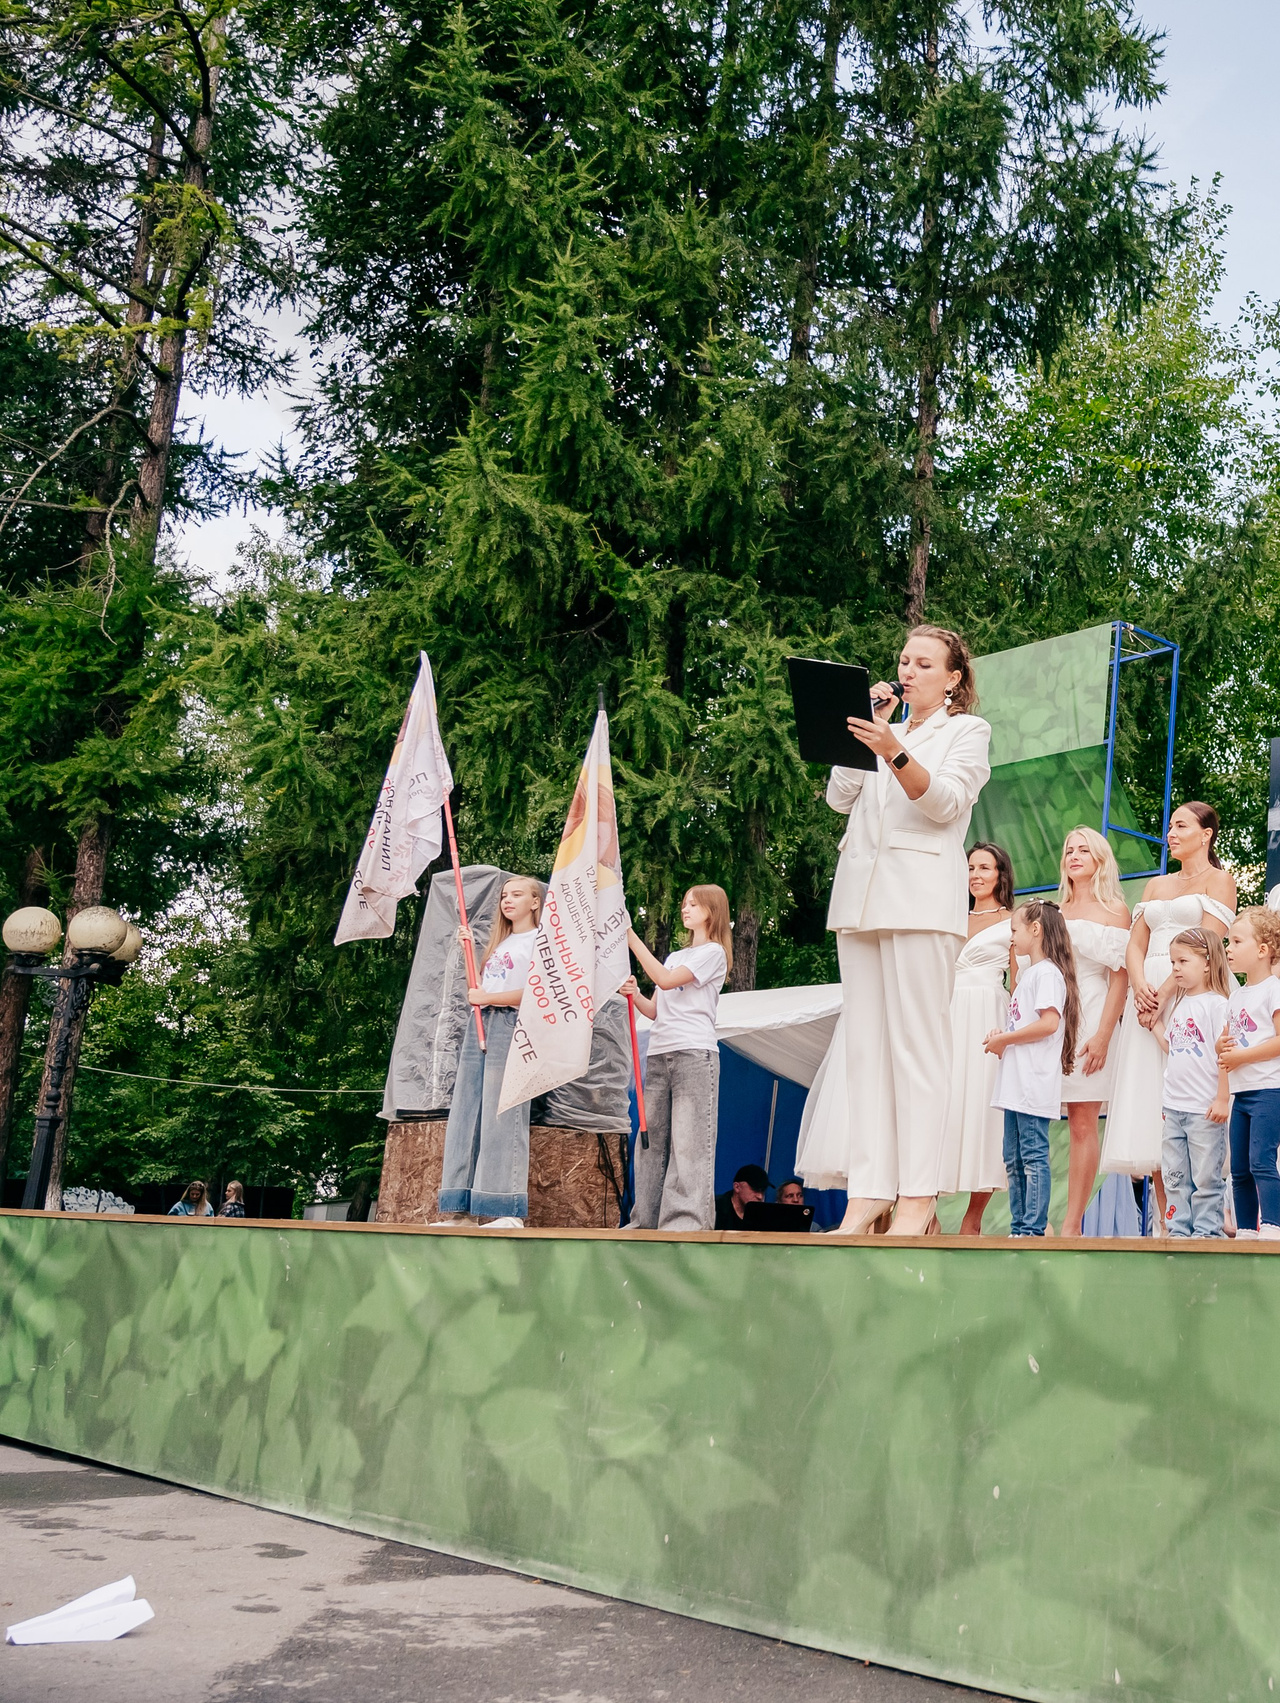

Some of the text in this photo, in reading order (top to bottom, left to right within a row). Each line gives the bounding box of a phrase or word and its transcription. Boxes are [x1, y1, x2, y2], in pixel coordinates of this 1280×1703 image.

[586, 865, 596, 878] 12
[545, 890, 585, 982] СРОЧНЫЙ
[561, 883, 588, 943] ДЮШЕННА
